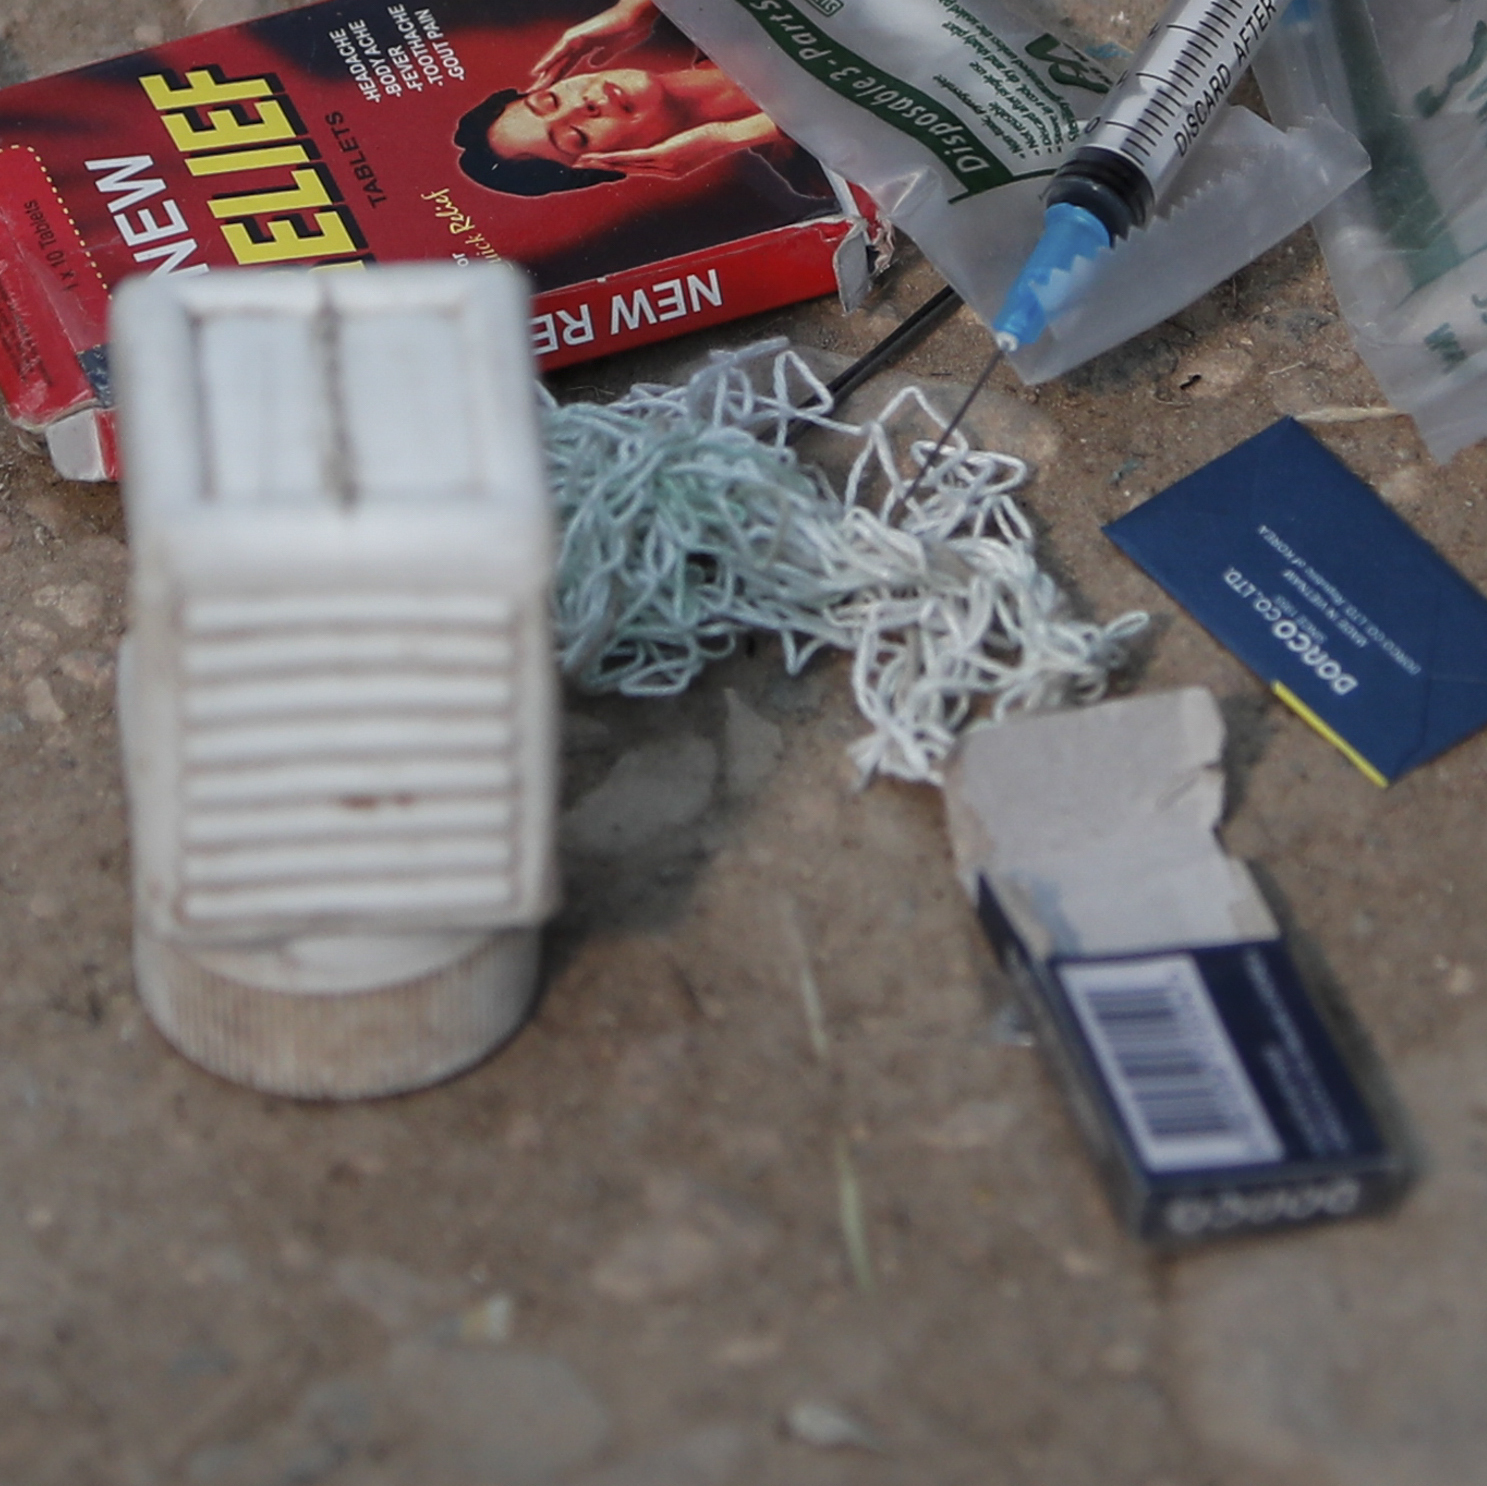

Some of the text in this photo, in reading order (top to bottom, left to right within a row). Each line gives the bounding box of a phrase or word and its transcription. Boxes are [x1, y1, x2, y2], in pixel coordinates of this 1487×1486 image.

[347, 18, 381, 53] ACHE
[414, 7, 444, 39] PAIN
[852, 73, 990, 173] Disposable
[1173, 61, 1236, 158] DISCARD
[138, 75, 366, 268] ELIEF
[323, 109, 388, 209] TABLETS
[20, 197, 59, 251] Tablets
[83, 148, 210, 280] NEW
[421, 187, 501, 263] uick Relief
[45, 247, 69, 268] 10
[59, 267, 76, 283] x
[451, 251, 469, 267] or
[527, 268, 723, 356] NEW RE
[1255, 521, 1297, 561] KOREA
[1290, 553, 1307, 571] of
[1219, 563, 1258, 601] LTD.
[1301, 563, 1348, 607] Republic
[1280, 565, 1370, 649] MADE IN VIETNAM
[1379, 637, 1422, 677] DORCO
